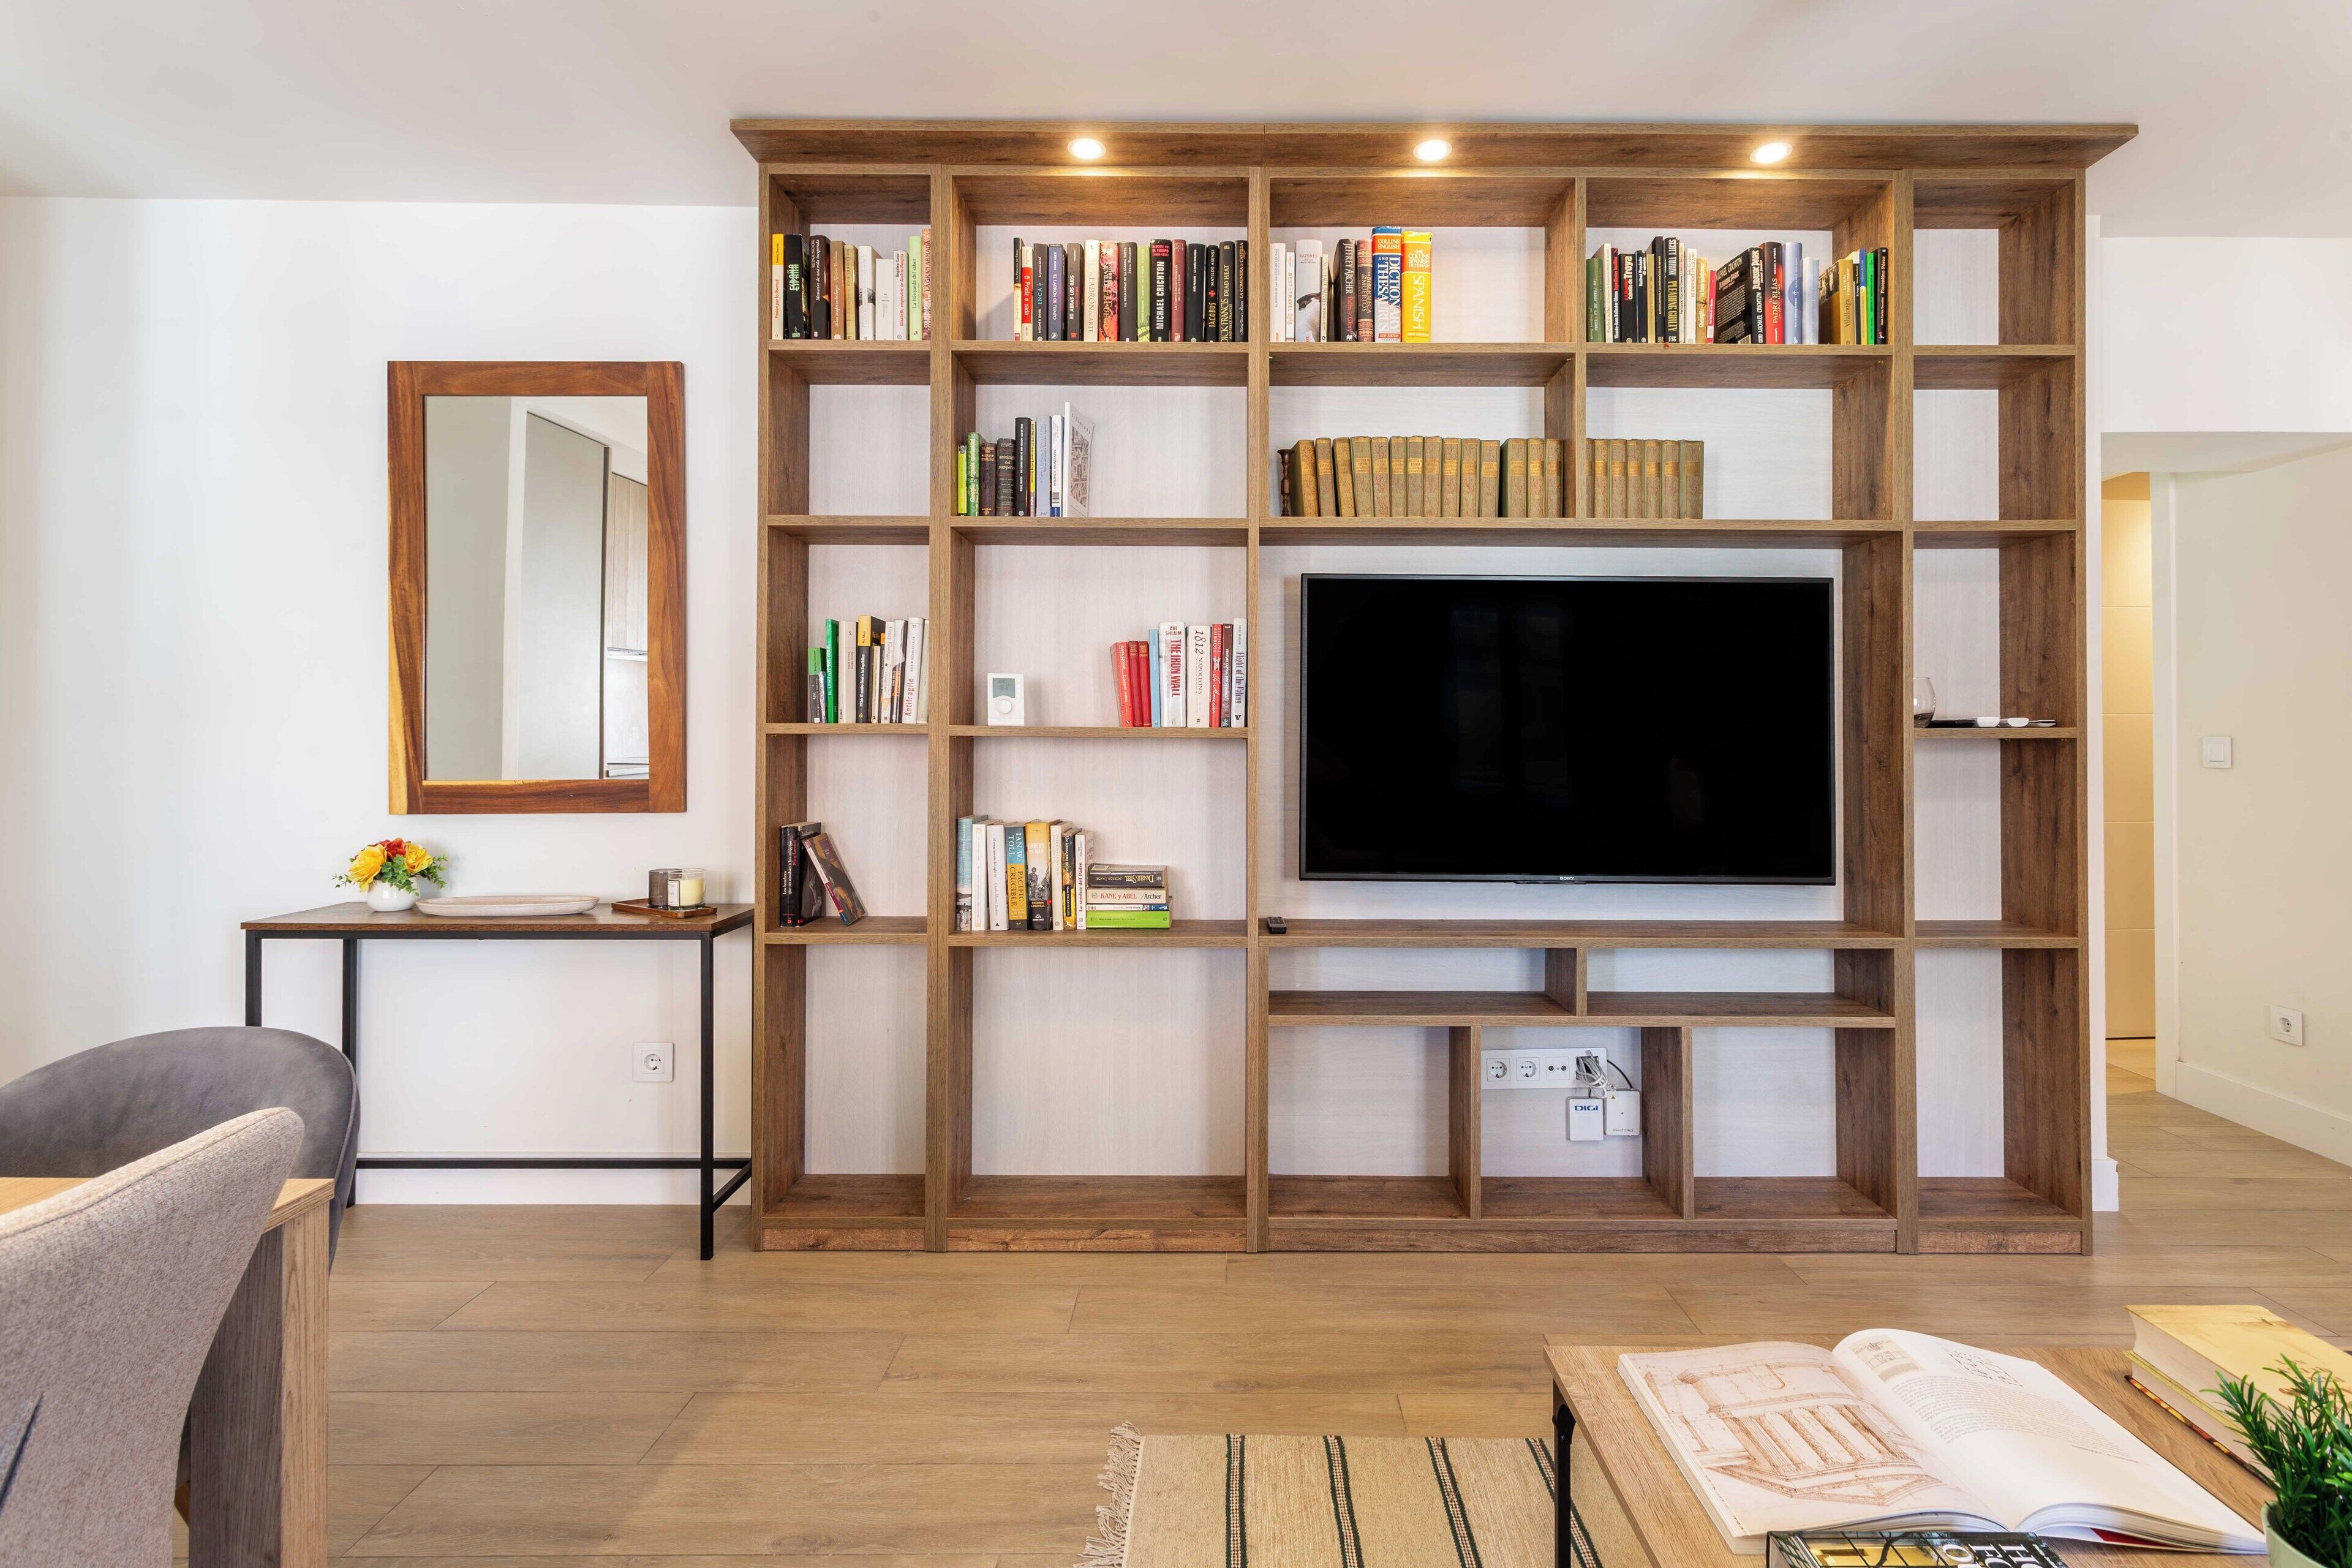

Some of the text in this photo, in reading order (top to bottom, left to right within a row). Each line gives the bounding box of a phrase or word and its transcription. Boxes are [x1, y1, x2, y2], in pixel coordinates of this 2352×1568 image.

[1343, 243, 1354, 294] JEFFREY ARCHER
[1624, 256, 1634, 279] Troya
[1668, 239, 1676, 276] SCOTT TUROW
[1751, 250, 1762, 290] JURASSIC PARK
[1156, 261, 1165, 296] CRICHTON
[1377, 260, 1389, 331] THESAURUS
[1389, 255, 1401, 334] DICTIONARY
[1156, 298, 1164, 330] MICHAEL
[1220, 298, 1229, 343] DICK FRANCIS
[1412, 274, 1425, 330] SPANISH
[1668, 281, 1677, 332] PLEADING GUILTY
[1194, 629, 1207, 655] 1812
[1234, 652, 1245, 669] Flight
[1170, 639, 1182, 698] THE IRON WALL
[1236, 676, 1245, 685] the
[905, 678, 914, 717] Antifragile
[1235, 686, 1245, 704] Falcon
[1017, 850, 1023, 859] W.
[1124, 875, 1155, 884] DANIELLE STEEL
